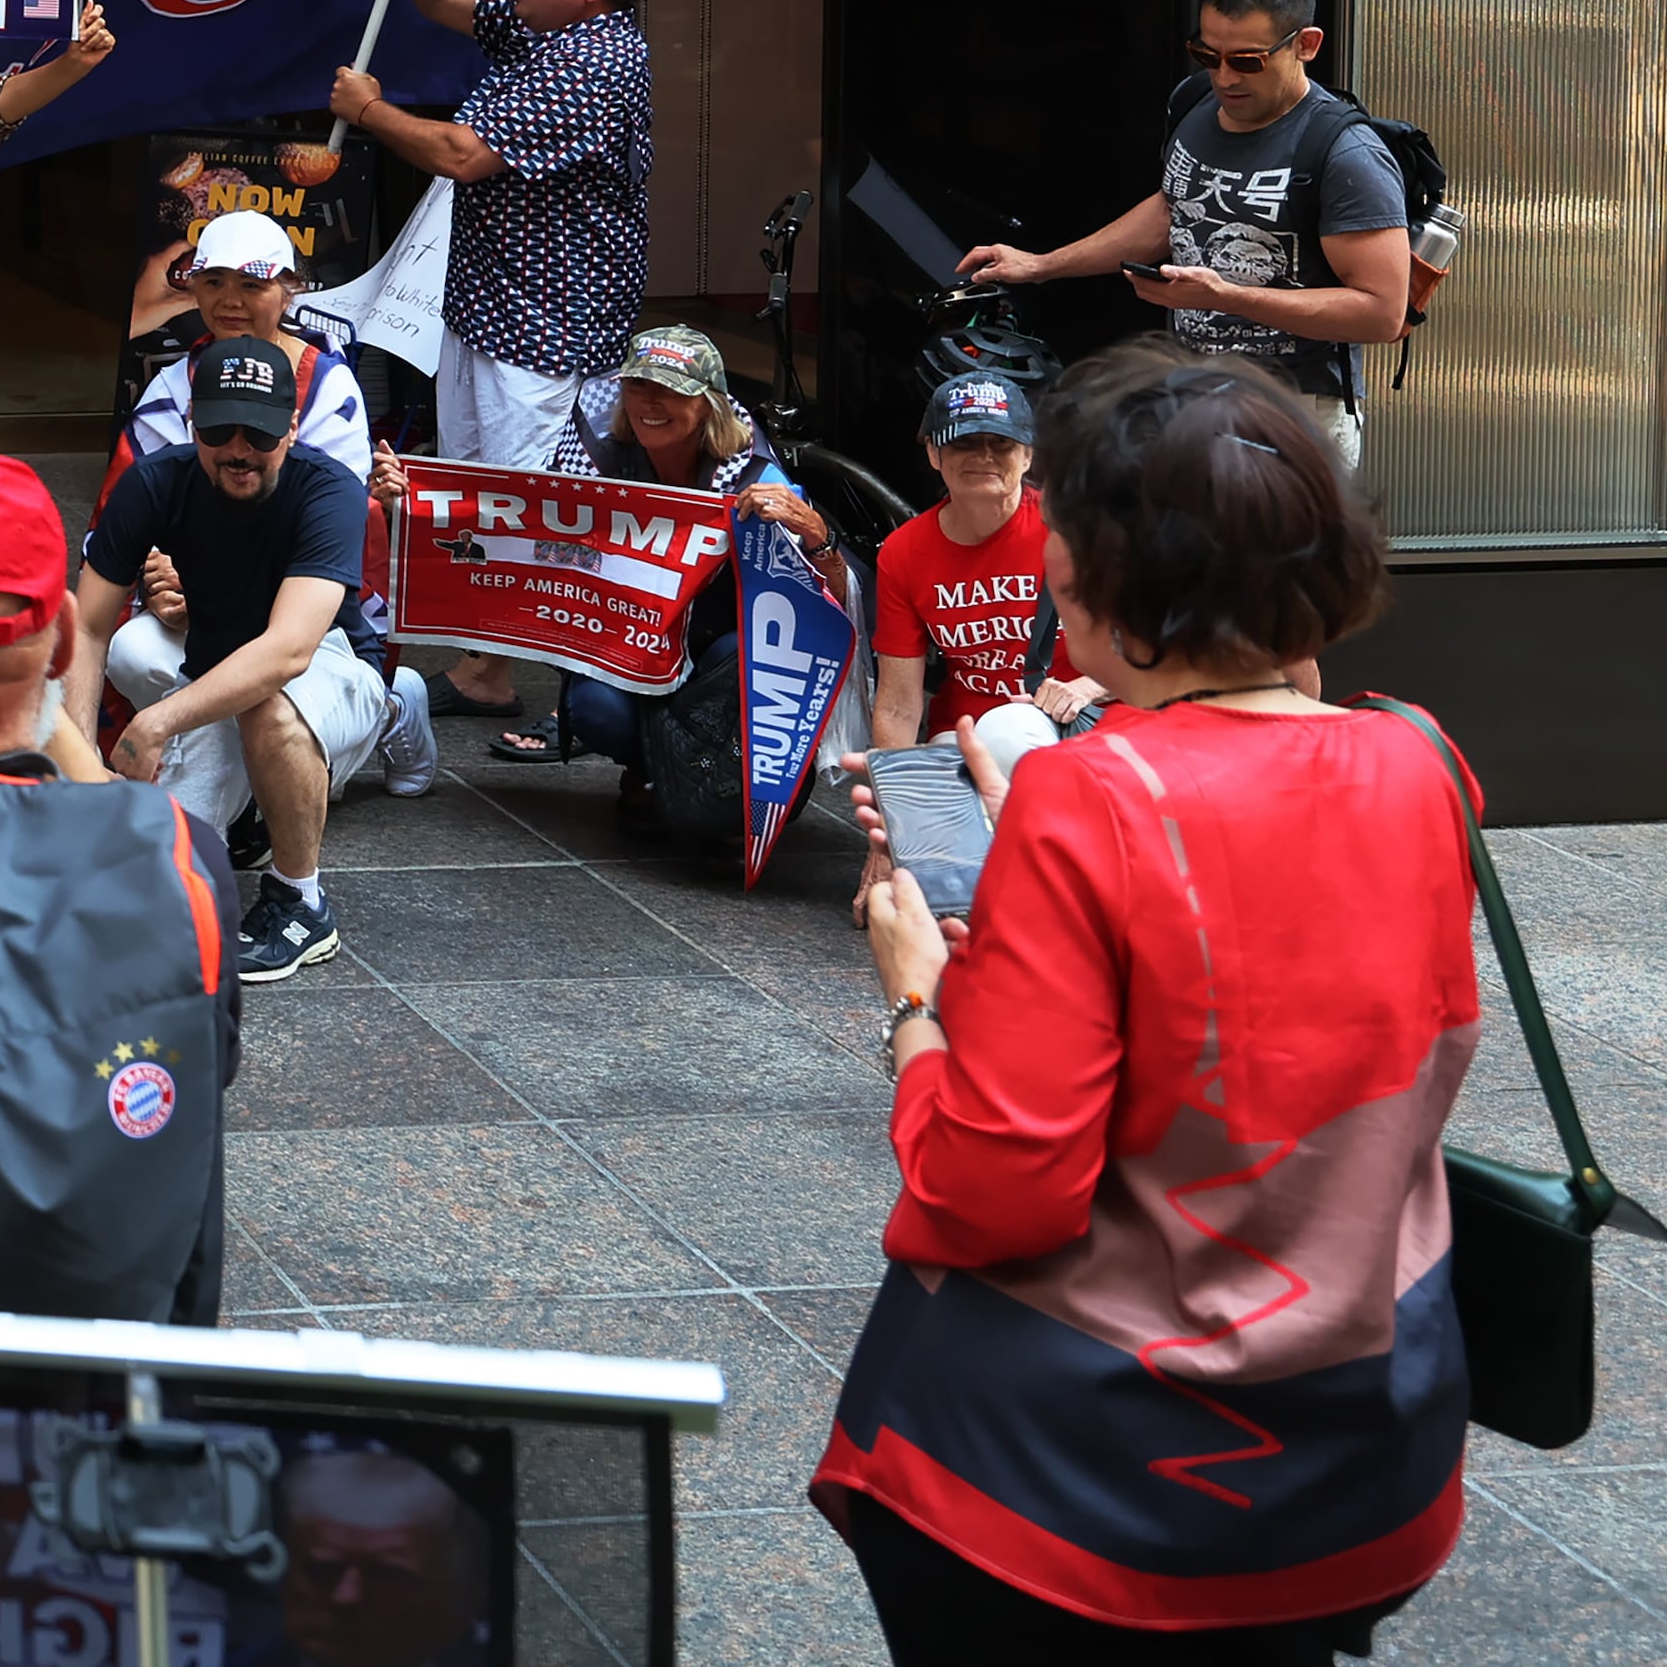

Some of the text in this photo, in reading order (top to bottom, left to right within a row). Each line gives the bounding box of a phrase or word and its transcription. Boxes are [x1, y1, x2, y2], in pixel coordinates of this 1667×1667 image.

[207, 184, 307, 218] NOW
[638, 336, 696, 361] Trump
[649, 354, 686, 370] 2024
[220, 357, 274, 386] FJB
[948, 385, 1007, 404] Trump
[417, 490, 731, 567] TRUMP
[741, 530, 753, 561] Keep
[753, 521, 766, 572] America
[470, 572, 663, 627] KEEP AMERICA GREAT!
[933, 574, 1038, 610] MAKE
[752, 591, 814, 786] TRUMP
[798, 655, 841, 732] Years!
[790, 733, 811, 764] More
